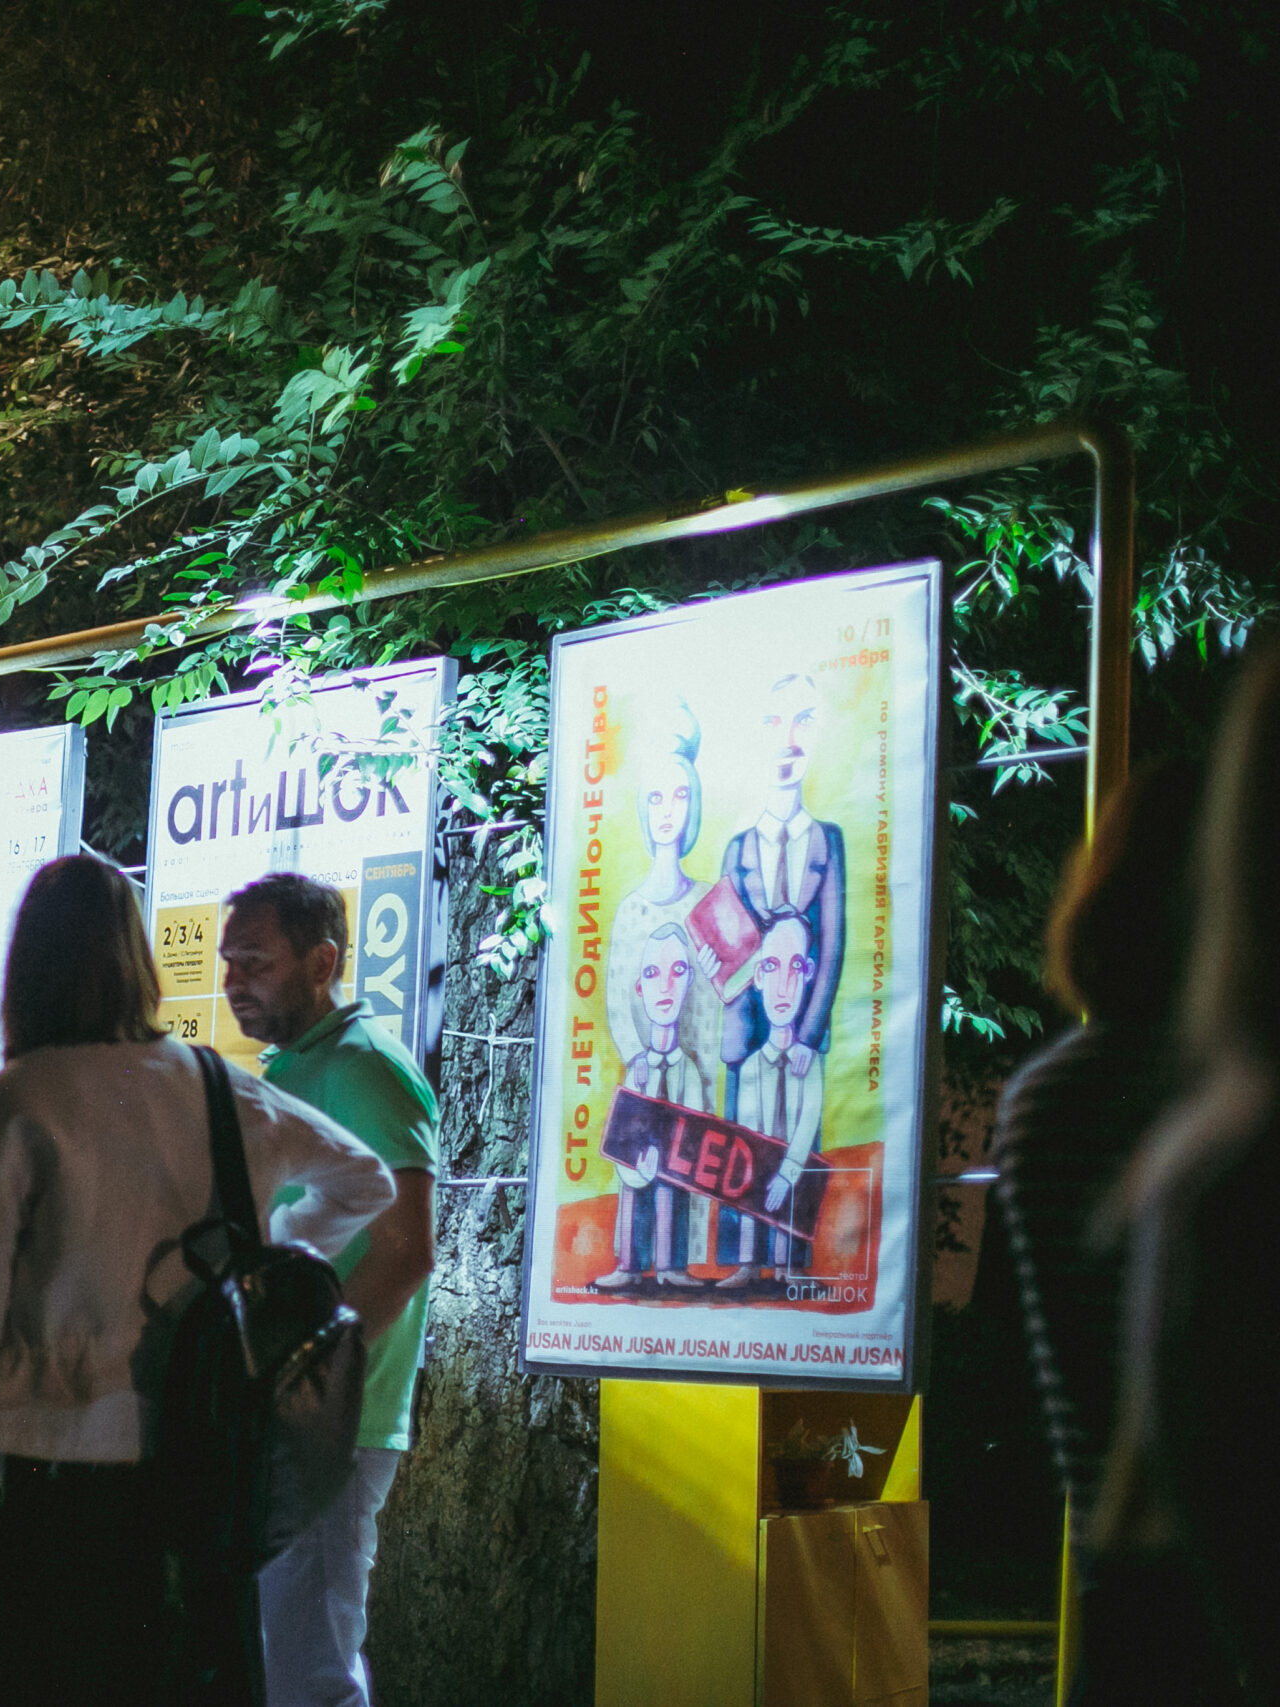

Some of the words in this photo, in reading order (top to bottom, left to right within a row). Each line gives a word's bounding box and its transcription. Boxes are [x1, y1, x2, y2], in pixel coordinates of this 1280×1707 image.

[365, 864, 416, 880] СЕНТЯБРЬ
[872, 809, 889, 911] ГАБРИЭЛЯ
[871, 914, 887, 993] ГАРСИА
[868, 999, 883, 1093] МАРКЕСА
[667, 1116, 755, 1199] LED
[574, 1334, 623, 1353] JUSAN
[625, 1336, 675, 1356] JUSAN
[678, 1339, 730, 1358] JUSAN
[733, 1341, 787, 1361] JUSAN
[790, 1344, 845, 1364] JUSAN
